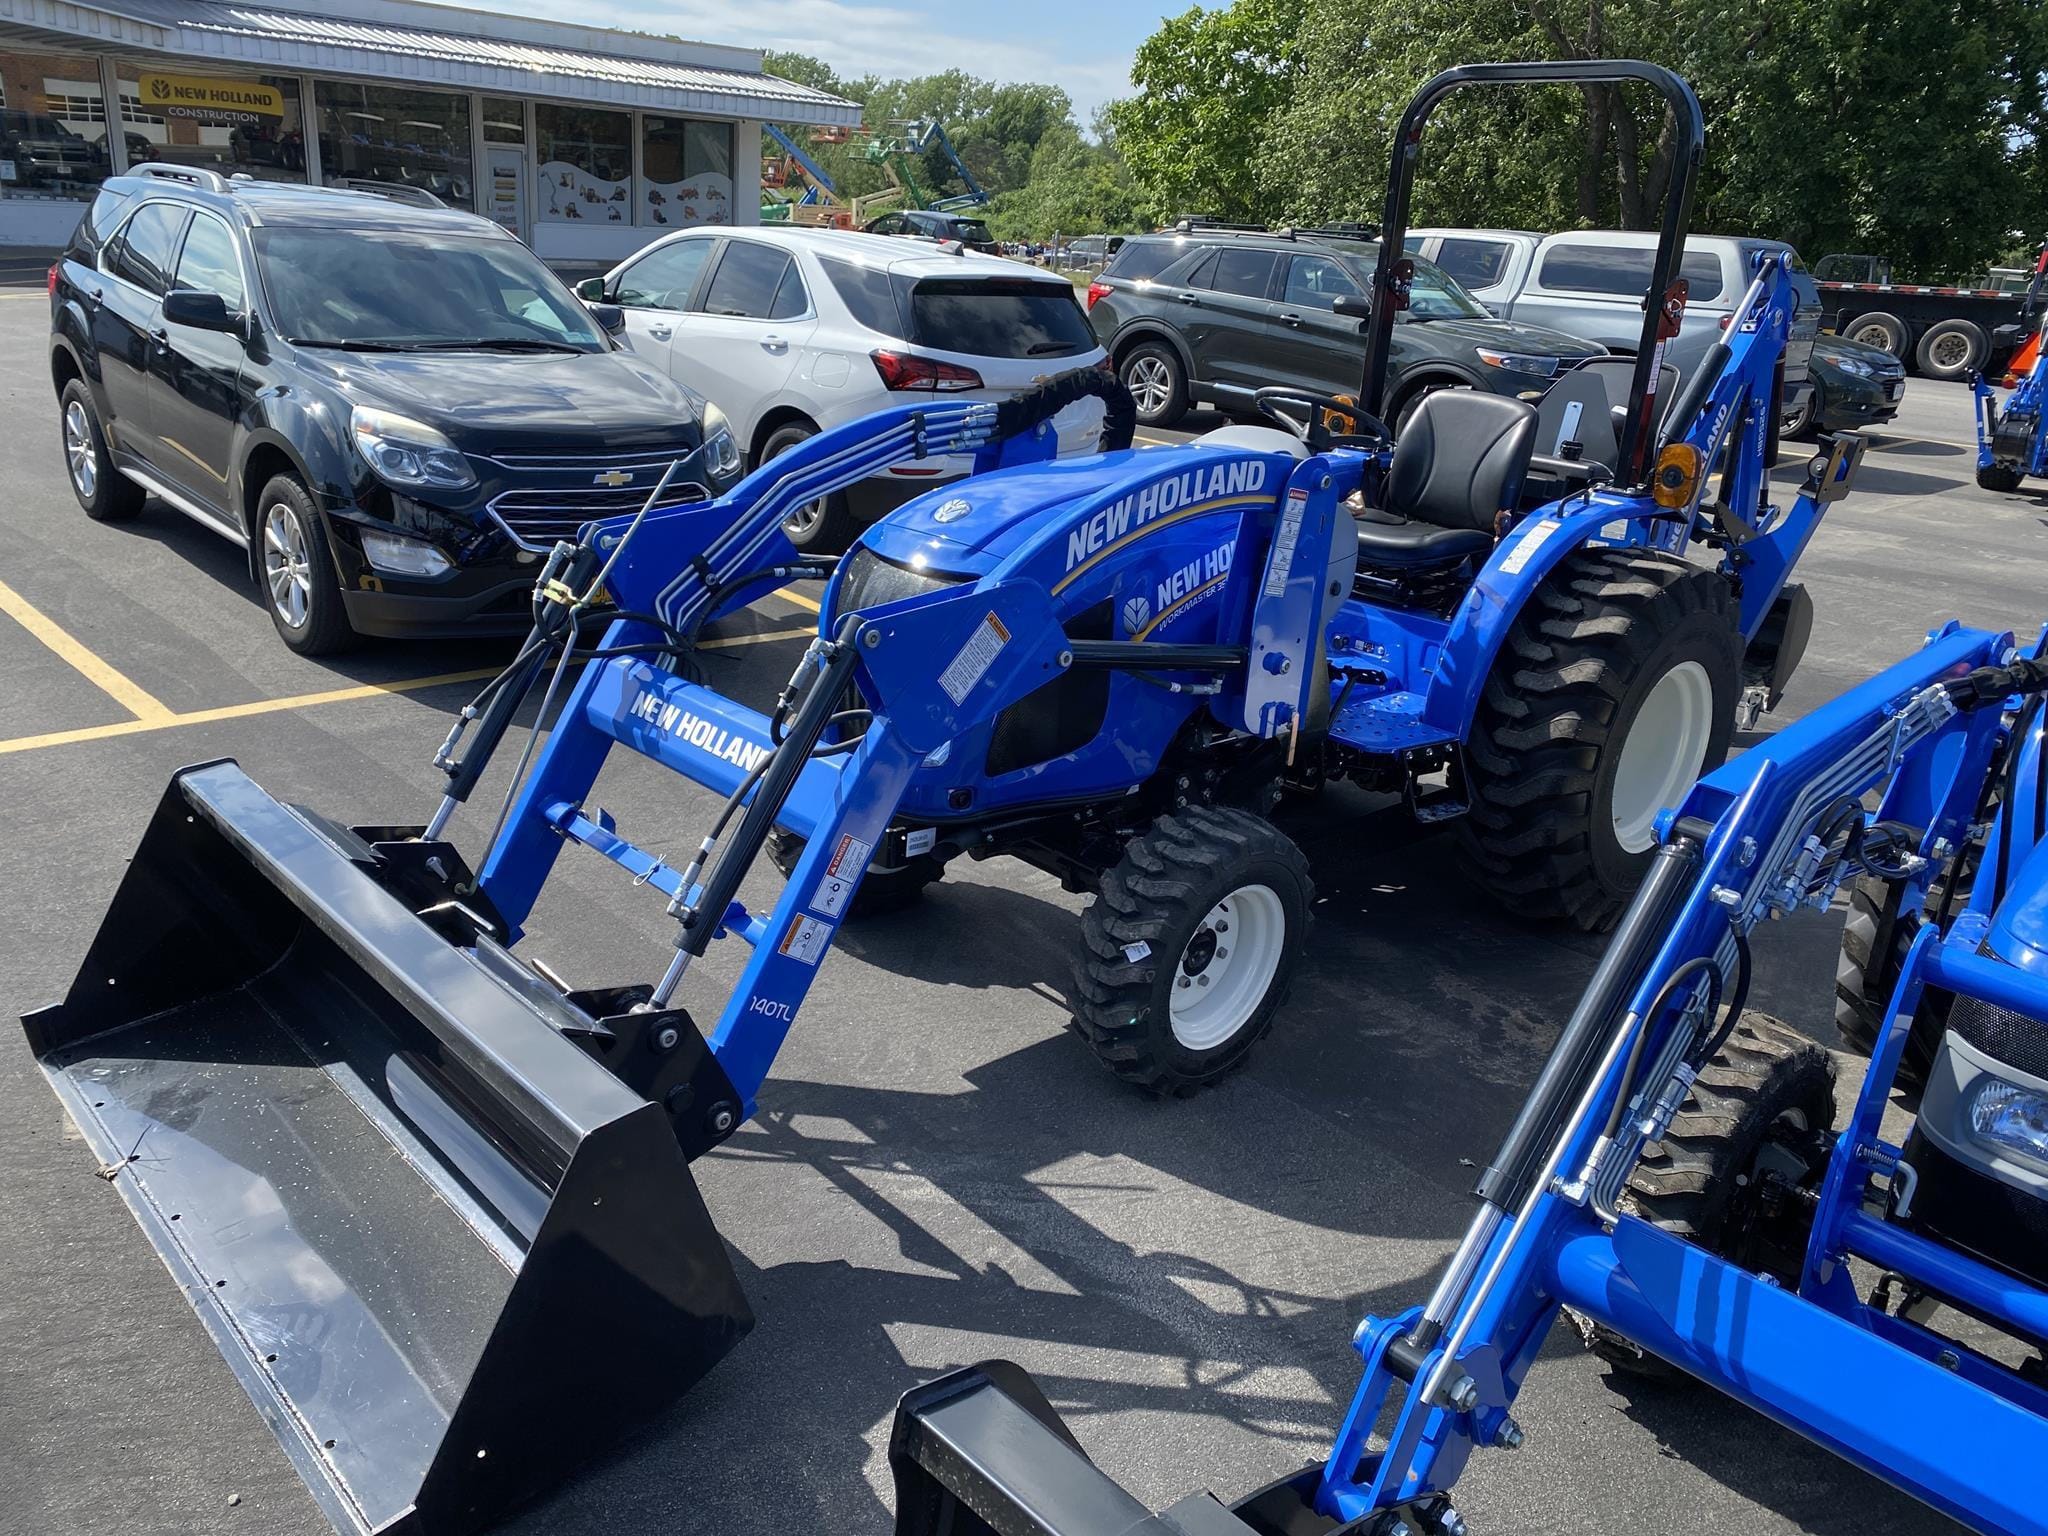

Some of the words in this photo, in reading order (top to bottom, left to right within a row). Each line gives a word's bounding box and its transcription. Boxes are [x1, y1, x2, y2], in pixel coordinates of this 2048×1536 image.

[168, 107, 259, 123] CONSTRUCTION
[174, 86, 207, 100] NEW
[210, 90, 272, 106] HOLLAND
[1065, 494, 1133, 572] NEW
[1136, 460, 1266, 526] HOLLAND
[1157, 558, 1201, 612] NEW
[1159, 585, 1216, 632] WORKMASTER
[630, 690, 681, 732] NEW
[749, 995, 791, 1022] 140TL
